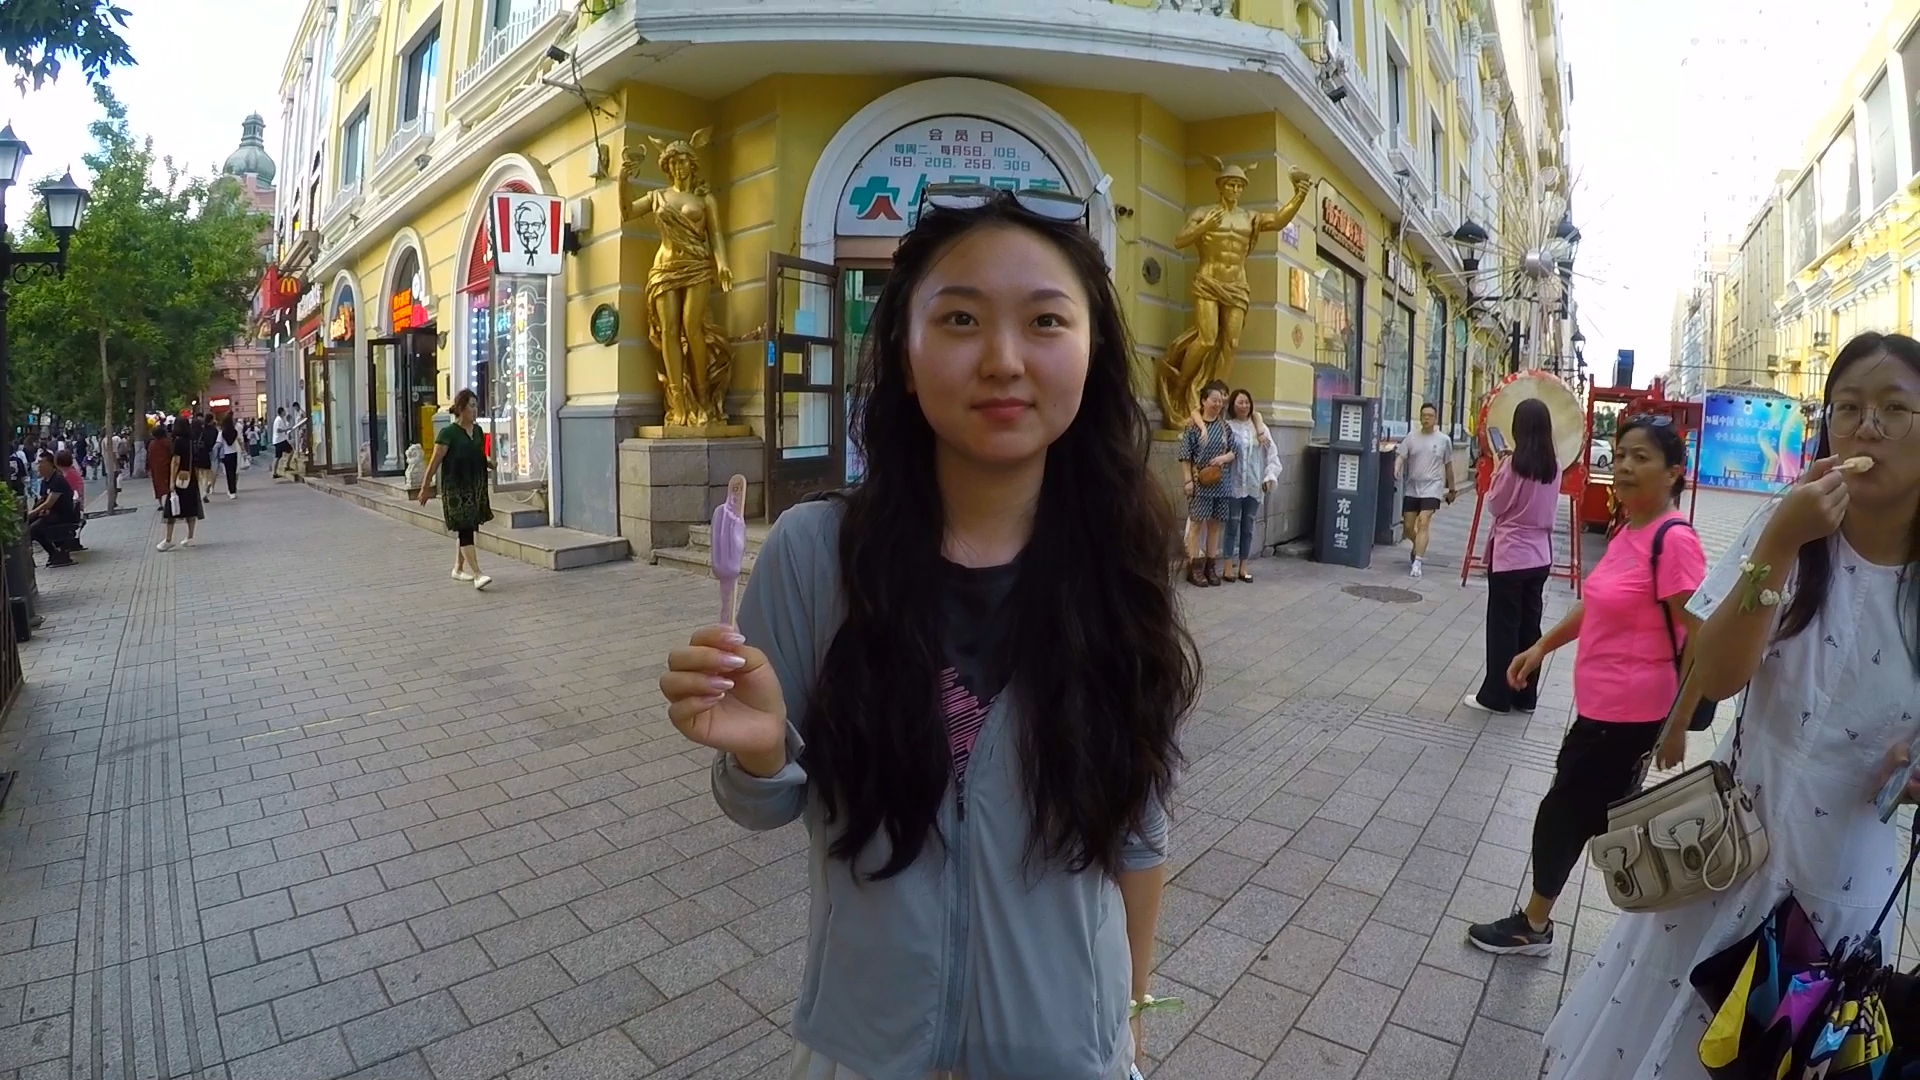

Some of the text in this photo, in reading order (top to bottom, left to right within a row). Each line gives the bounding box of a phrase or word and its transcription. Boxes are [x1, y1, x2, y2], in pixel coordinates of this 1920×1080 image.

[929, 128, 993, 143] 会员日
[1334, 498, 1352, 549] 充电宝
